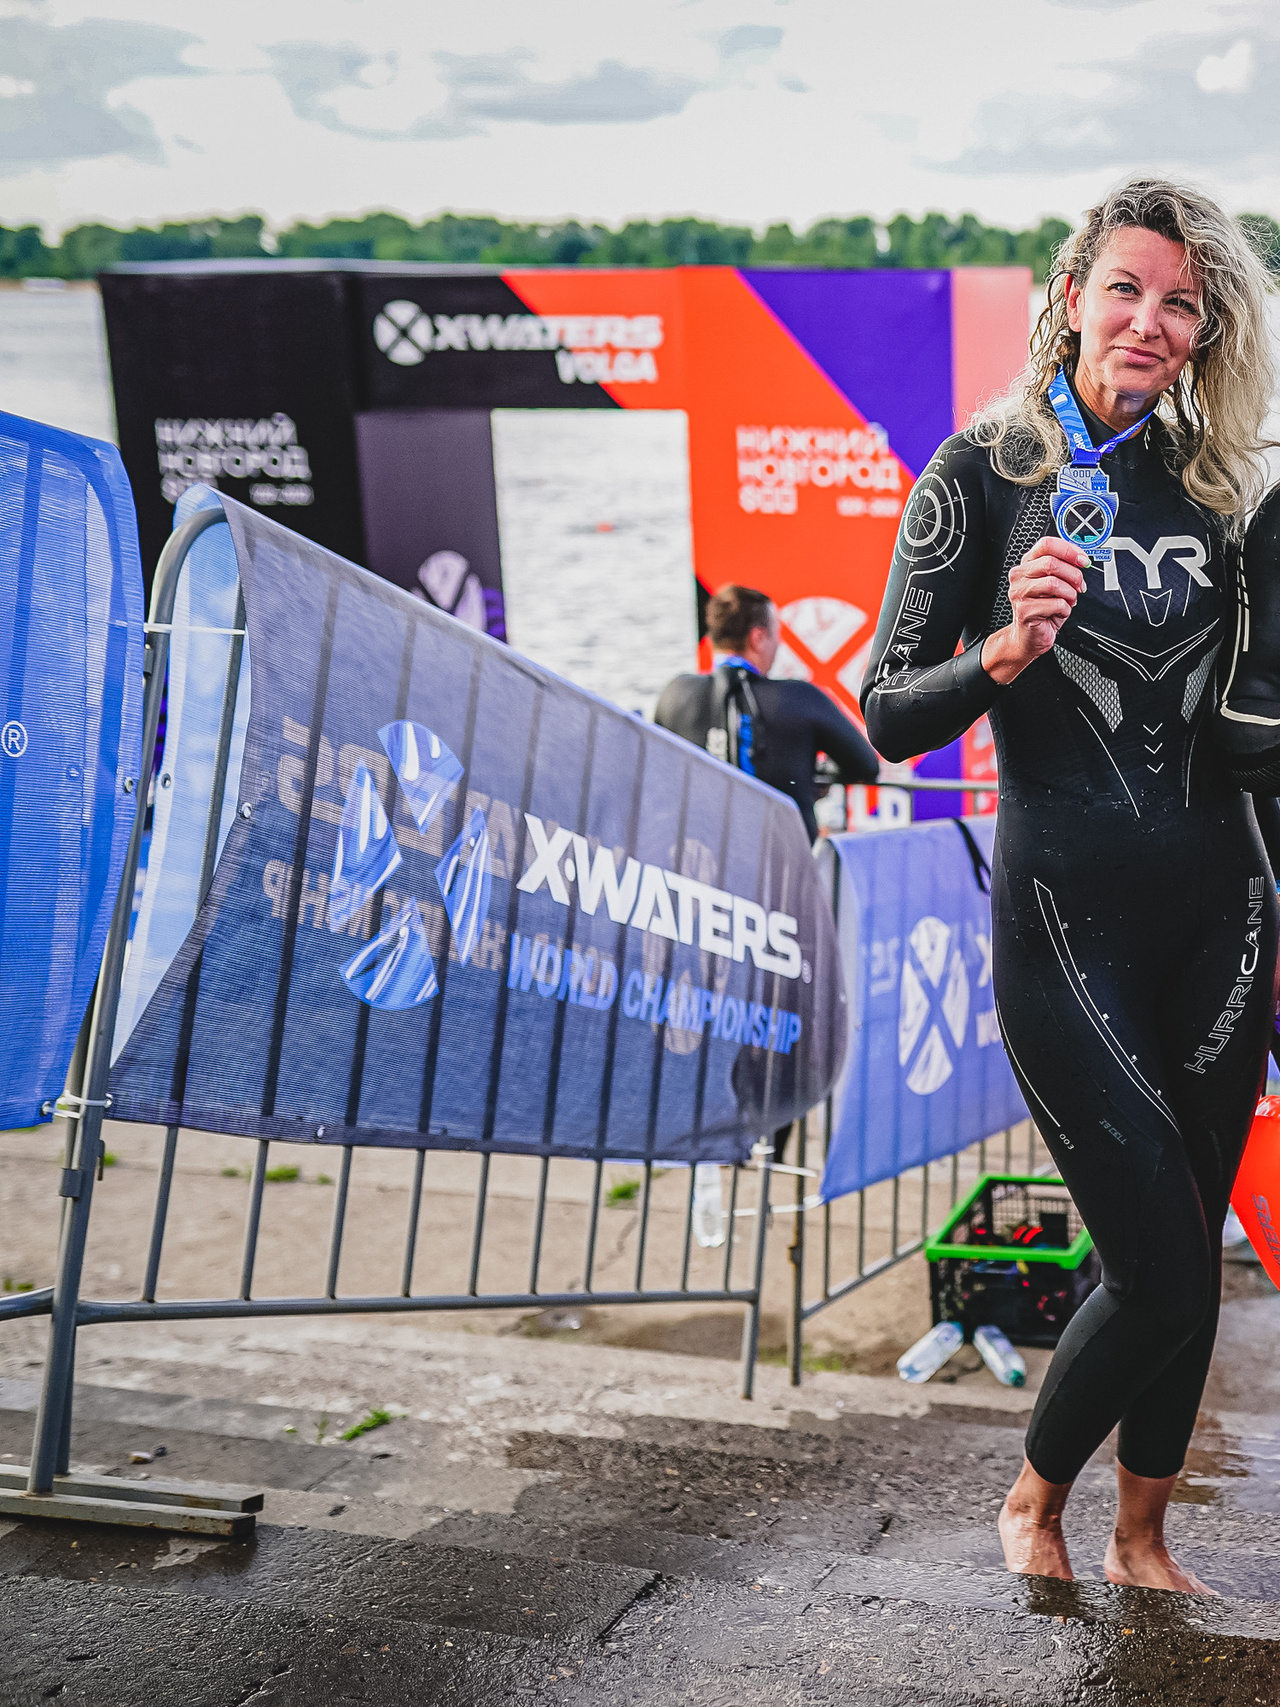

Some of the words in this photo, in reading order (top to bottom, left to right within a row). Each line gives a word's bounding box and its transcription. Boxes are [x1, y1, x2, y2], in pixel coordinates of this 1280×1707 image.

[555, 350, 658, 384] VOLGA
[738, 455, 902, 492] НОВГОРОД
[1100, 535, 1214, 591] TYR
[507, 932, 619, 1011] WORLD
[622, 968, 802, 1054] CHAMPIONSHIP
[1183, 876, 1265, 1075] HURRICANE
